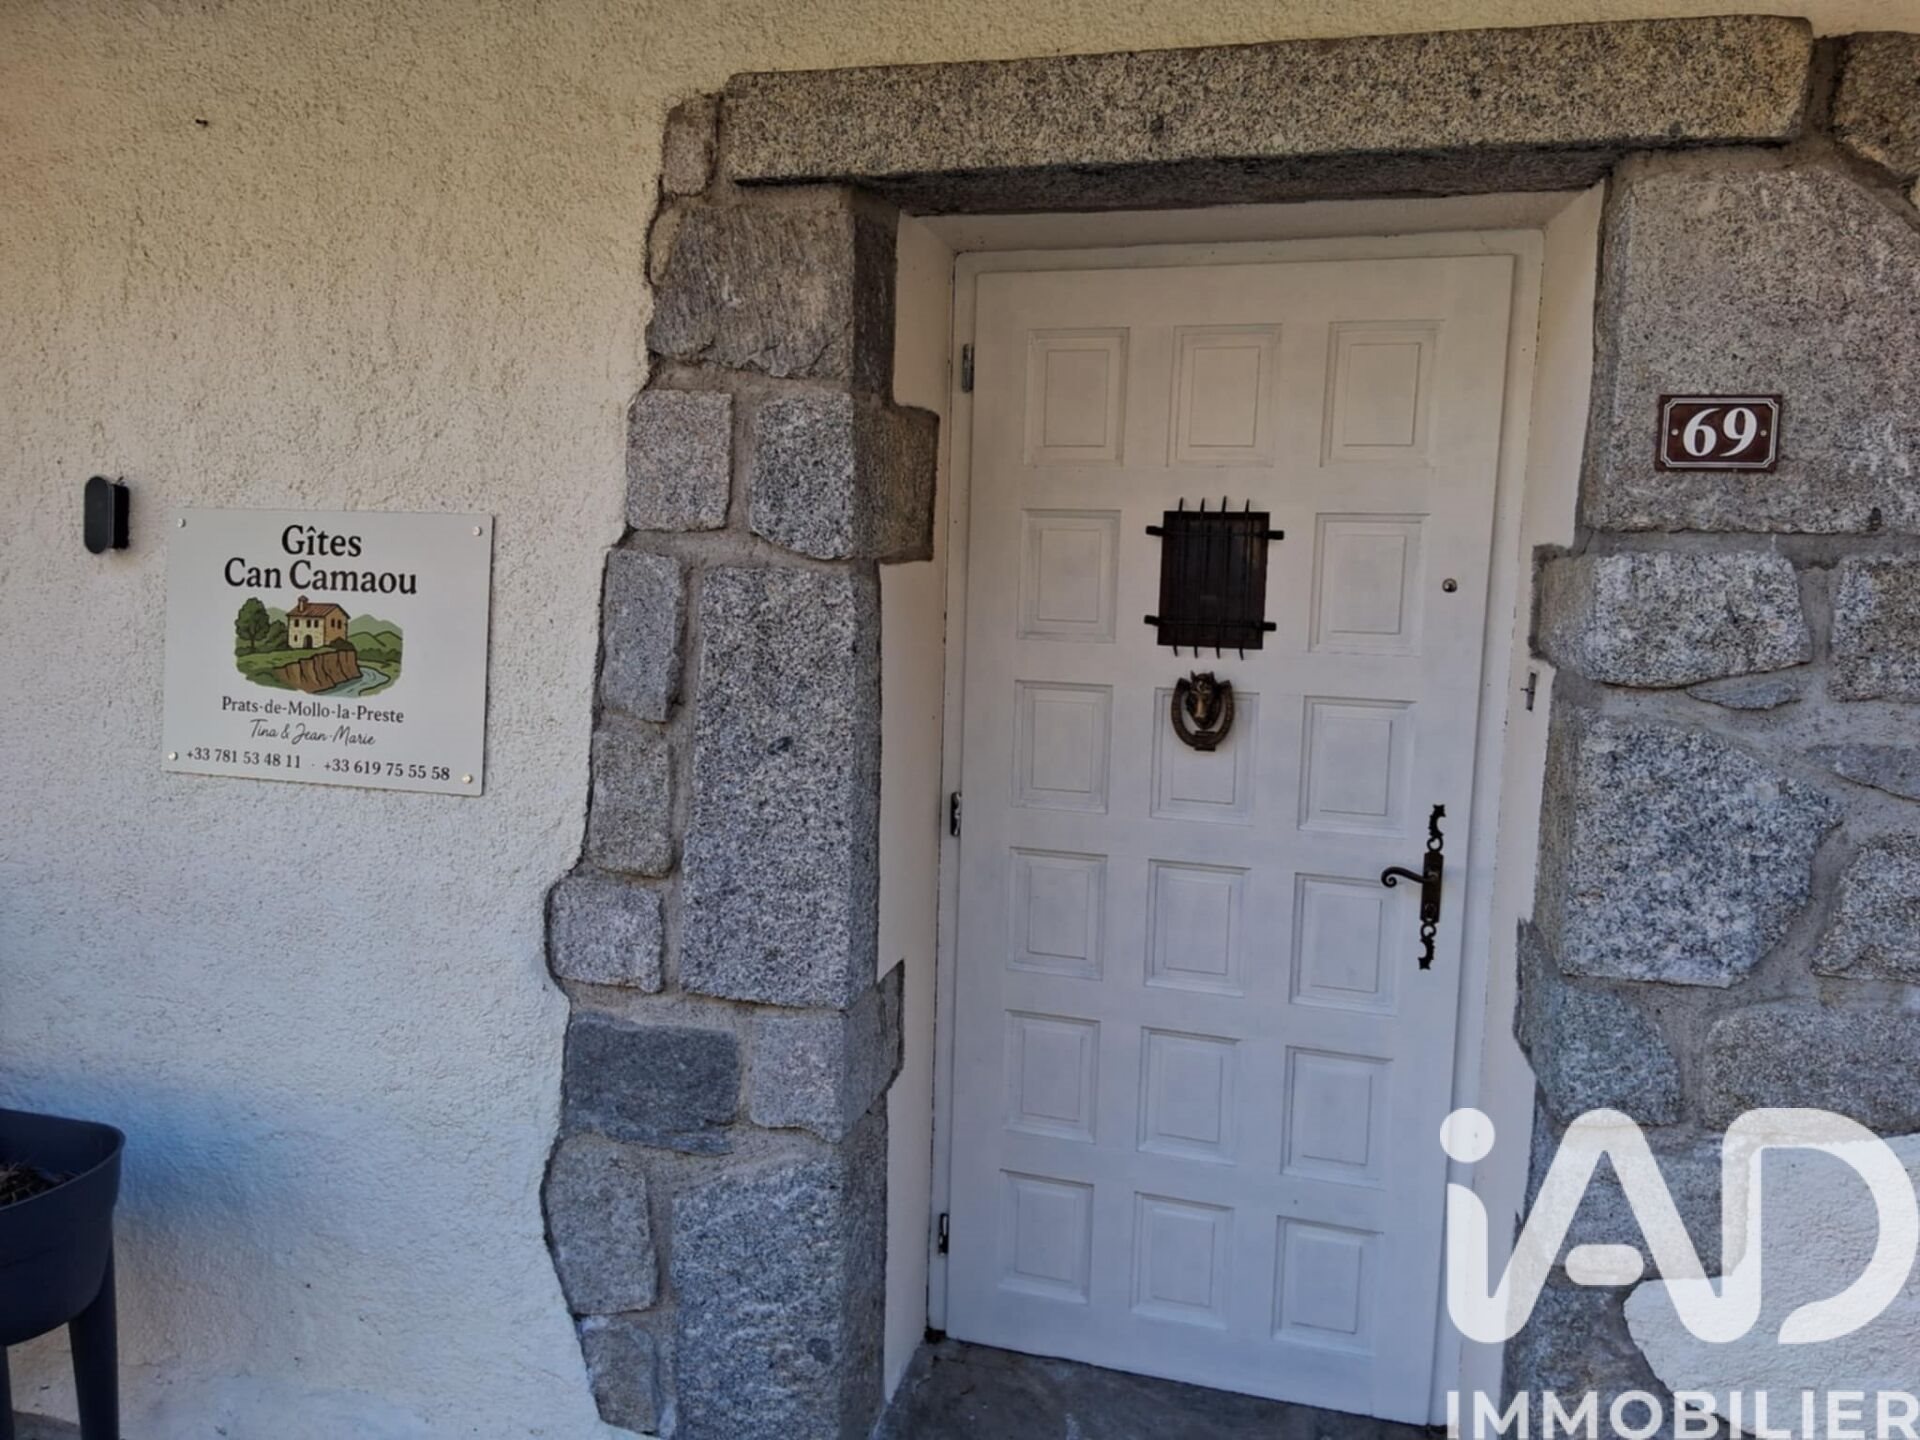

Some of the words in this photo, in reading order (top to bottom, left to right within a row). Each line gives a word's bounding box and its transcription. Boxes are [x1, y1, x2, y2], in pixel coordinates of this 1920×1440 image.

[1683, 407, 1757, 456] 69
[281, 524, 362, 557] Gîtes
[224, 557, 282, 589] Can
[289, 560, 417, 594] Camaou
[222, 696, 404, 723] Prats-de-Mollo-la-Preste
[250, 718, 278, 738] Tina
[277, 723, 290, 739] &
[186, 747, 210, 761] +33
[215, 748, 238, 763] 781
[243, 750, 260, 765] 53
[264, 752, 281, 767] 48
[286, 754, 301, 768] 11
[324, 758, 350, 773] +33
[353, 760, 381, 775] 619
[386, 762, 404, 777] 75
[408, 764, 427, 780] 55
[432, 766, 450, 781] 58
